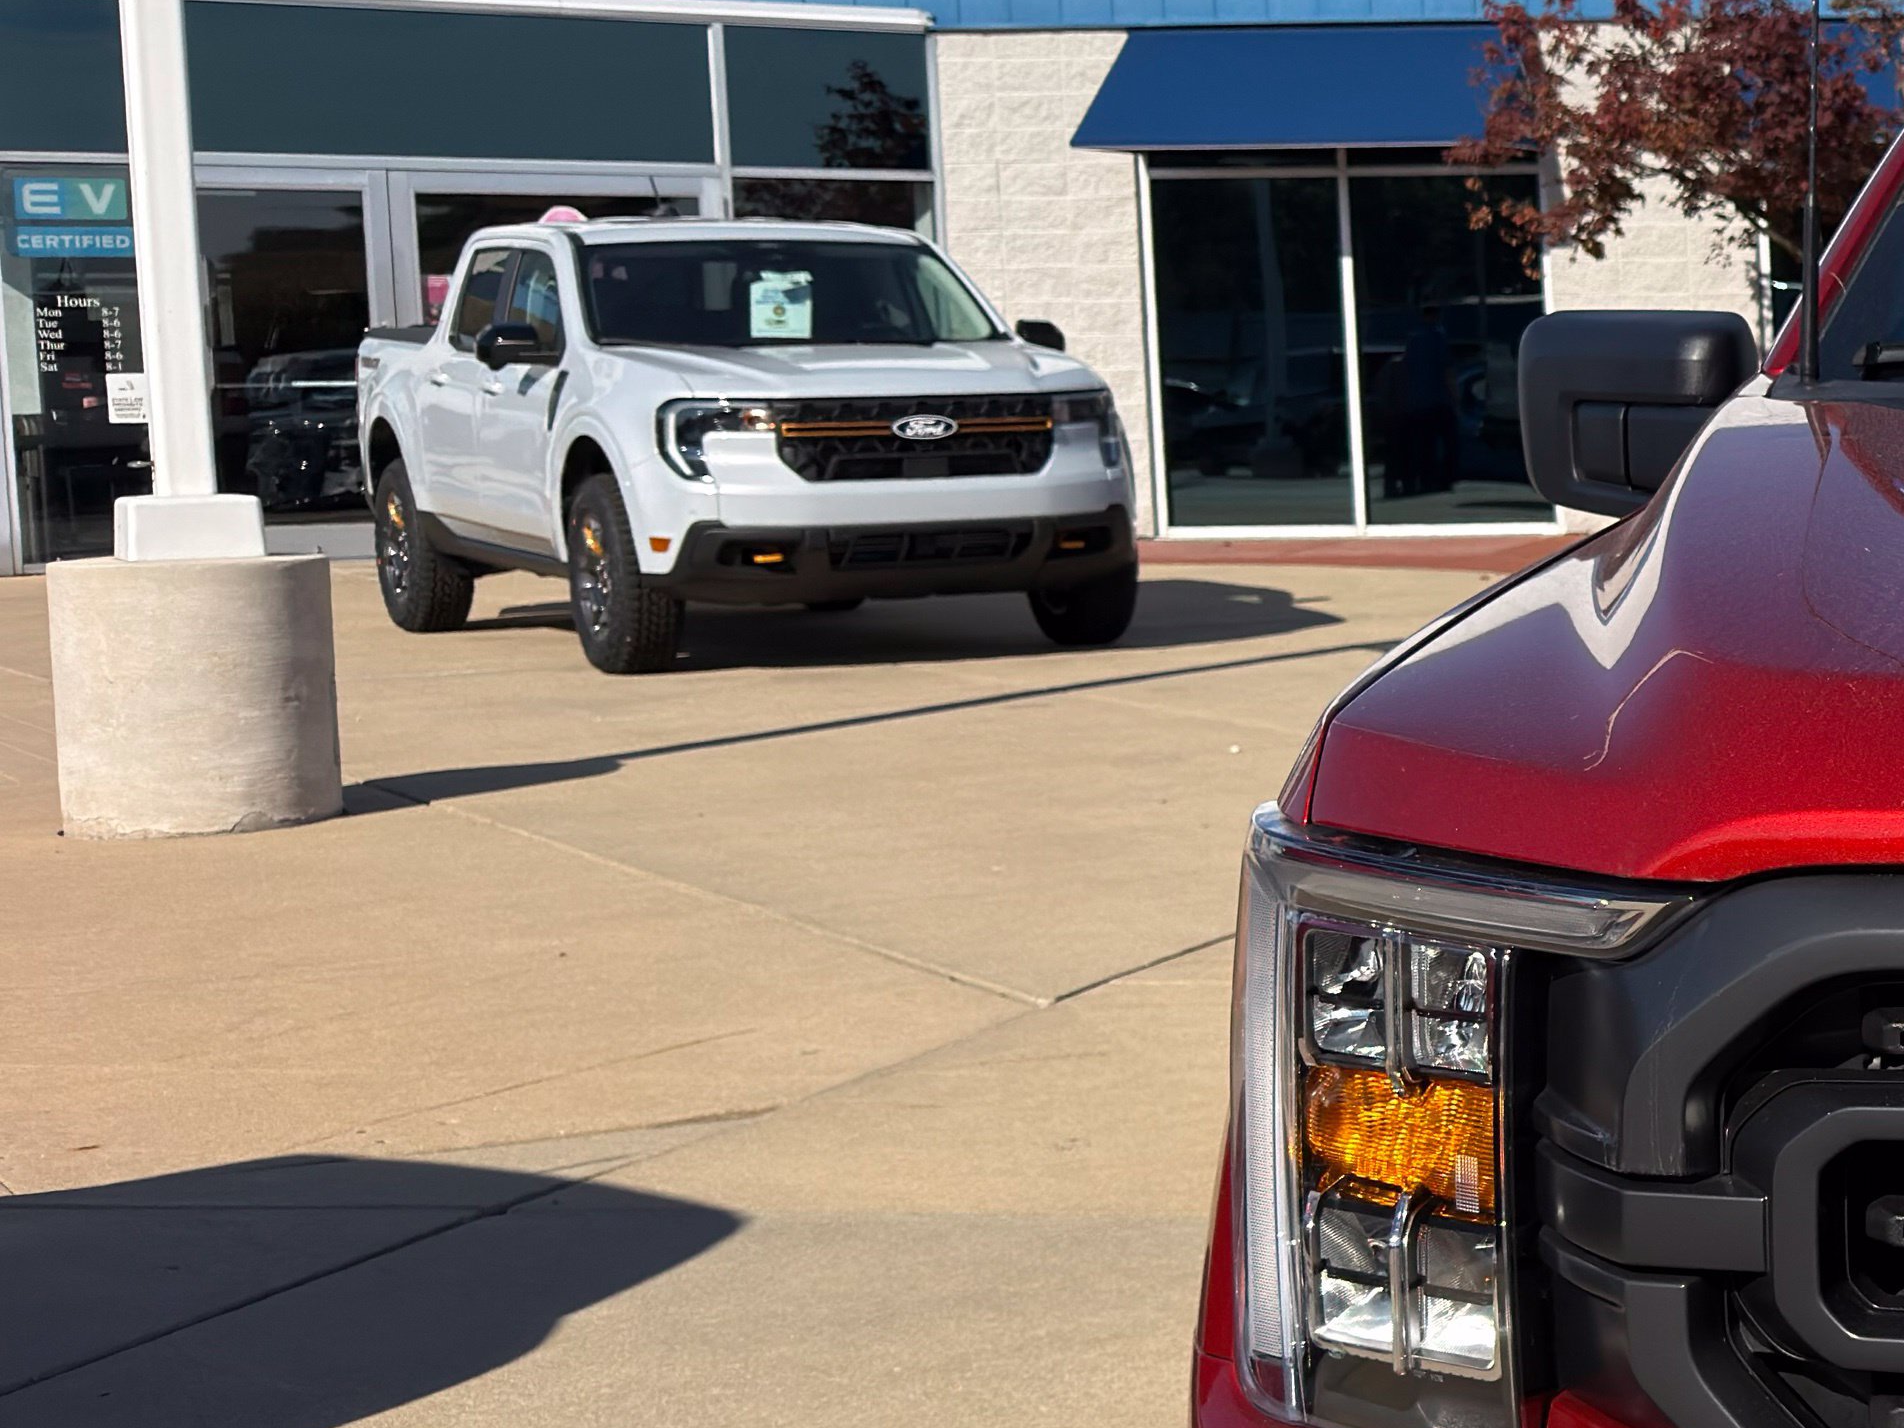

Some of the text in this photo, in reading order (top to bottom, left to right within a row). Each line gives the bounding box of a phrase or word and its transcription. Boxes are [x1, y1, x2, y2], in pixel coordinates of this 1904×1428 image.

[21, 182, 116, 215] EV
[16, 235, 131, 249] CERTIFIED
[56, 295, 100, 308] Hours
[36, 307, 120, 317] Mon 8-7
[37, 318, 58, 328] Tue
[38, 329, 63, 339] Wed
[38, 340, 65, 350] Thur
[39, 351, 56, 361] Fri
[40, 362, 58, 372] Sat
